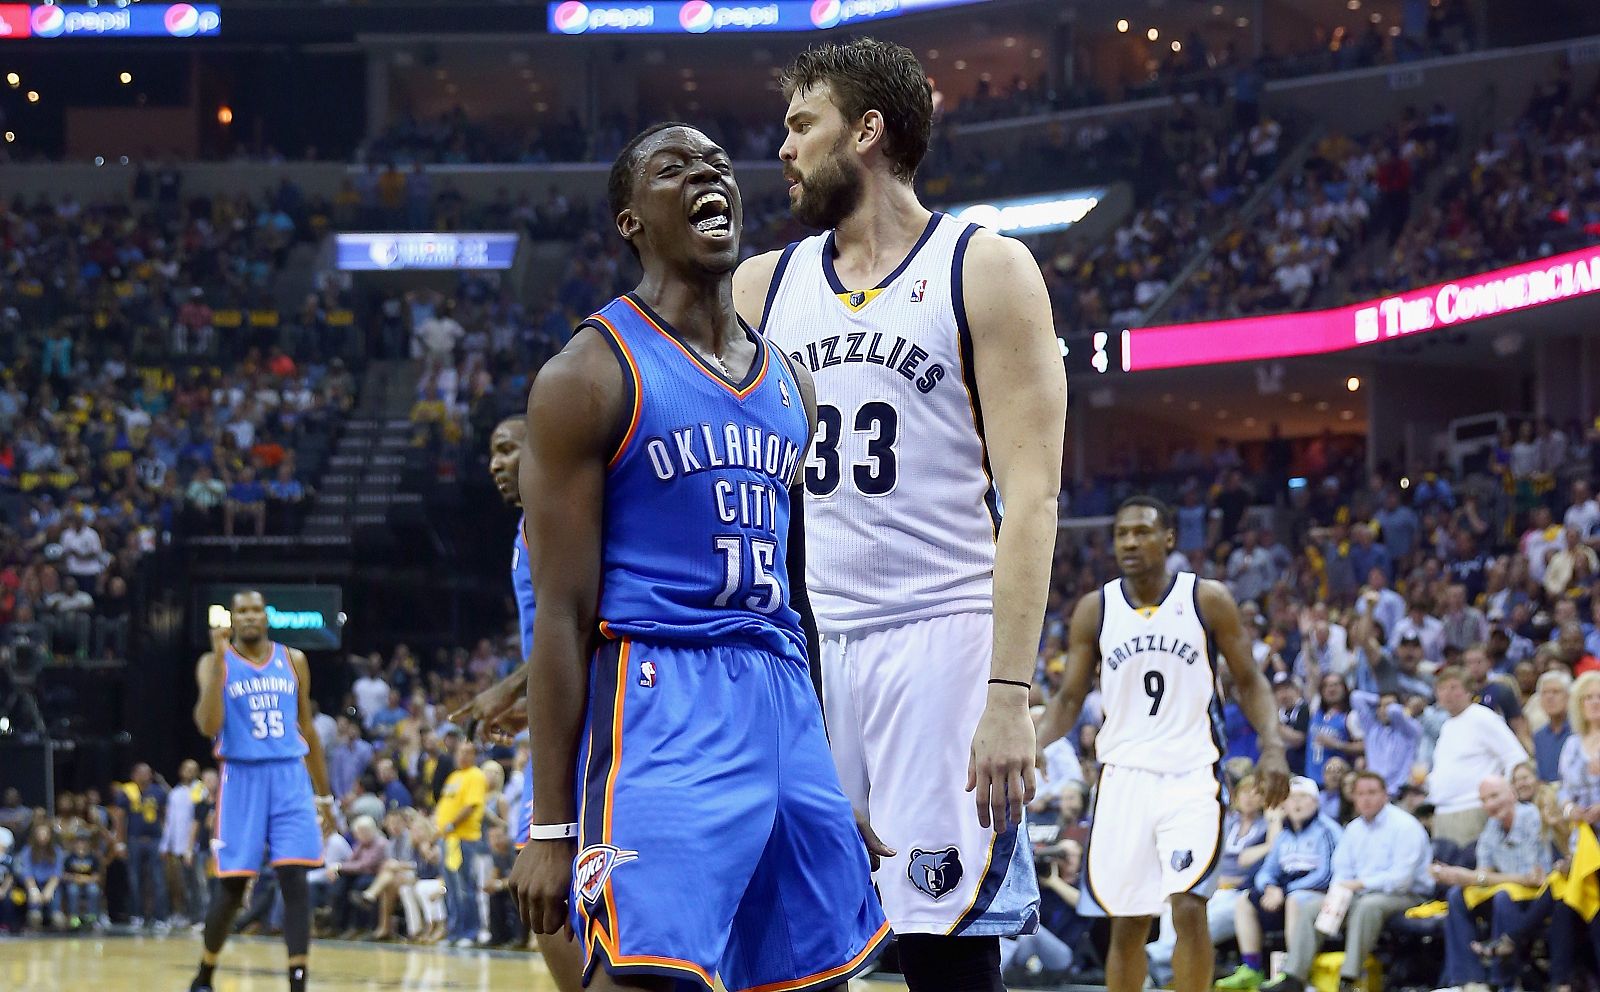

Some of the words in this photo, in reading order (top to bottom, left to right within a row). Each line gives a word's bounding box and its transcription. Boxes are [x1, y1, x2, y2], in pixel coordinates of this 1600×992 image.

[65, 9, 130, 33] pepsi
[589, 6, 654, 29] pepsi
[713, 4, 778, 29] pepsi
[841, 0, 898, 20] pepsi
[789, 332, 945, 394] RIZZLIES
[648, 421, 800, 491] OKLAHOM
[804, 401, 899, 498] 33
[714, 480, 777, 533] CITY
[713, 535, 783, 615] 15
[1107, 634, 1199, 671] GRIZZLIES
[228, 677, 296, 698] OKLAHOMA
[248, 694, 280, 711] CITY
[1143, 670, 1165, 716] 9
[250, 710, 285, 739] 35
